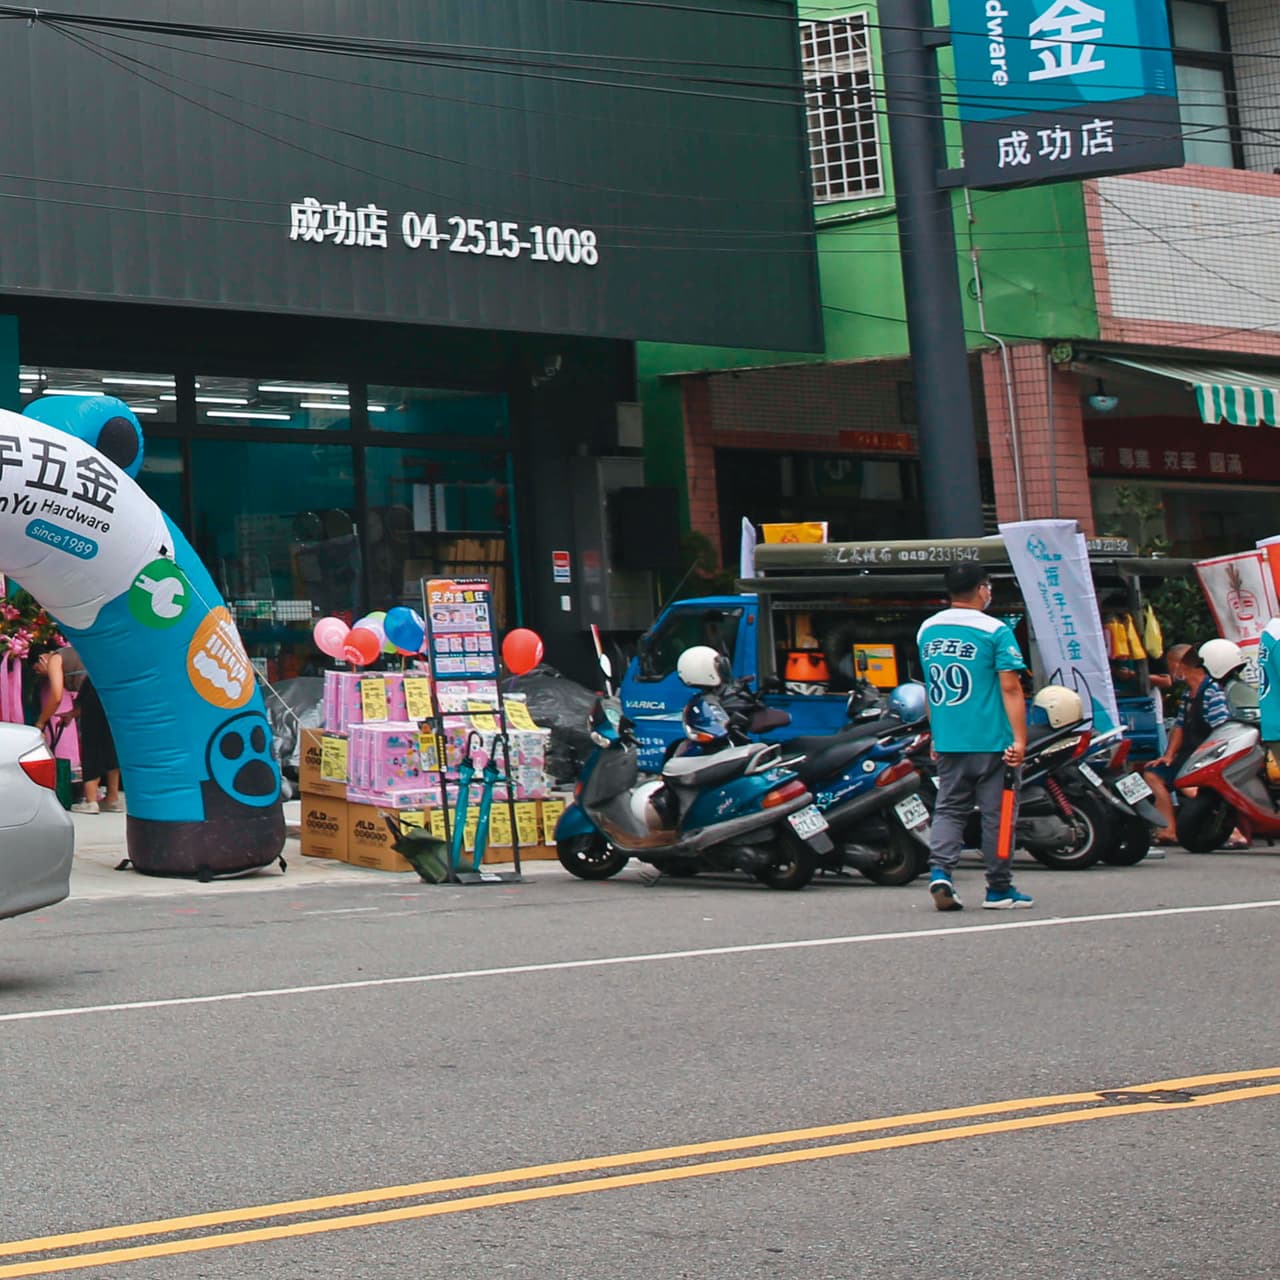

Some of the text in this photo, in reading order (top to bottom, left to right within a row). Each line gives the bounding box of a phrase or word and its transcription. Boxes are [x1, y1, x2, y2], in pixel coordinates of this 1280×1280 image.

[997, 117, 1115, 168] 成功店
[289, 196, 600, 267] 成功店 04-2515-1008
[40, 498, 111, 533] Hardware
[626, 700, 666, 710] VARICA
[929, 664, 972, 705] 89
